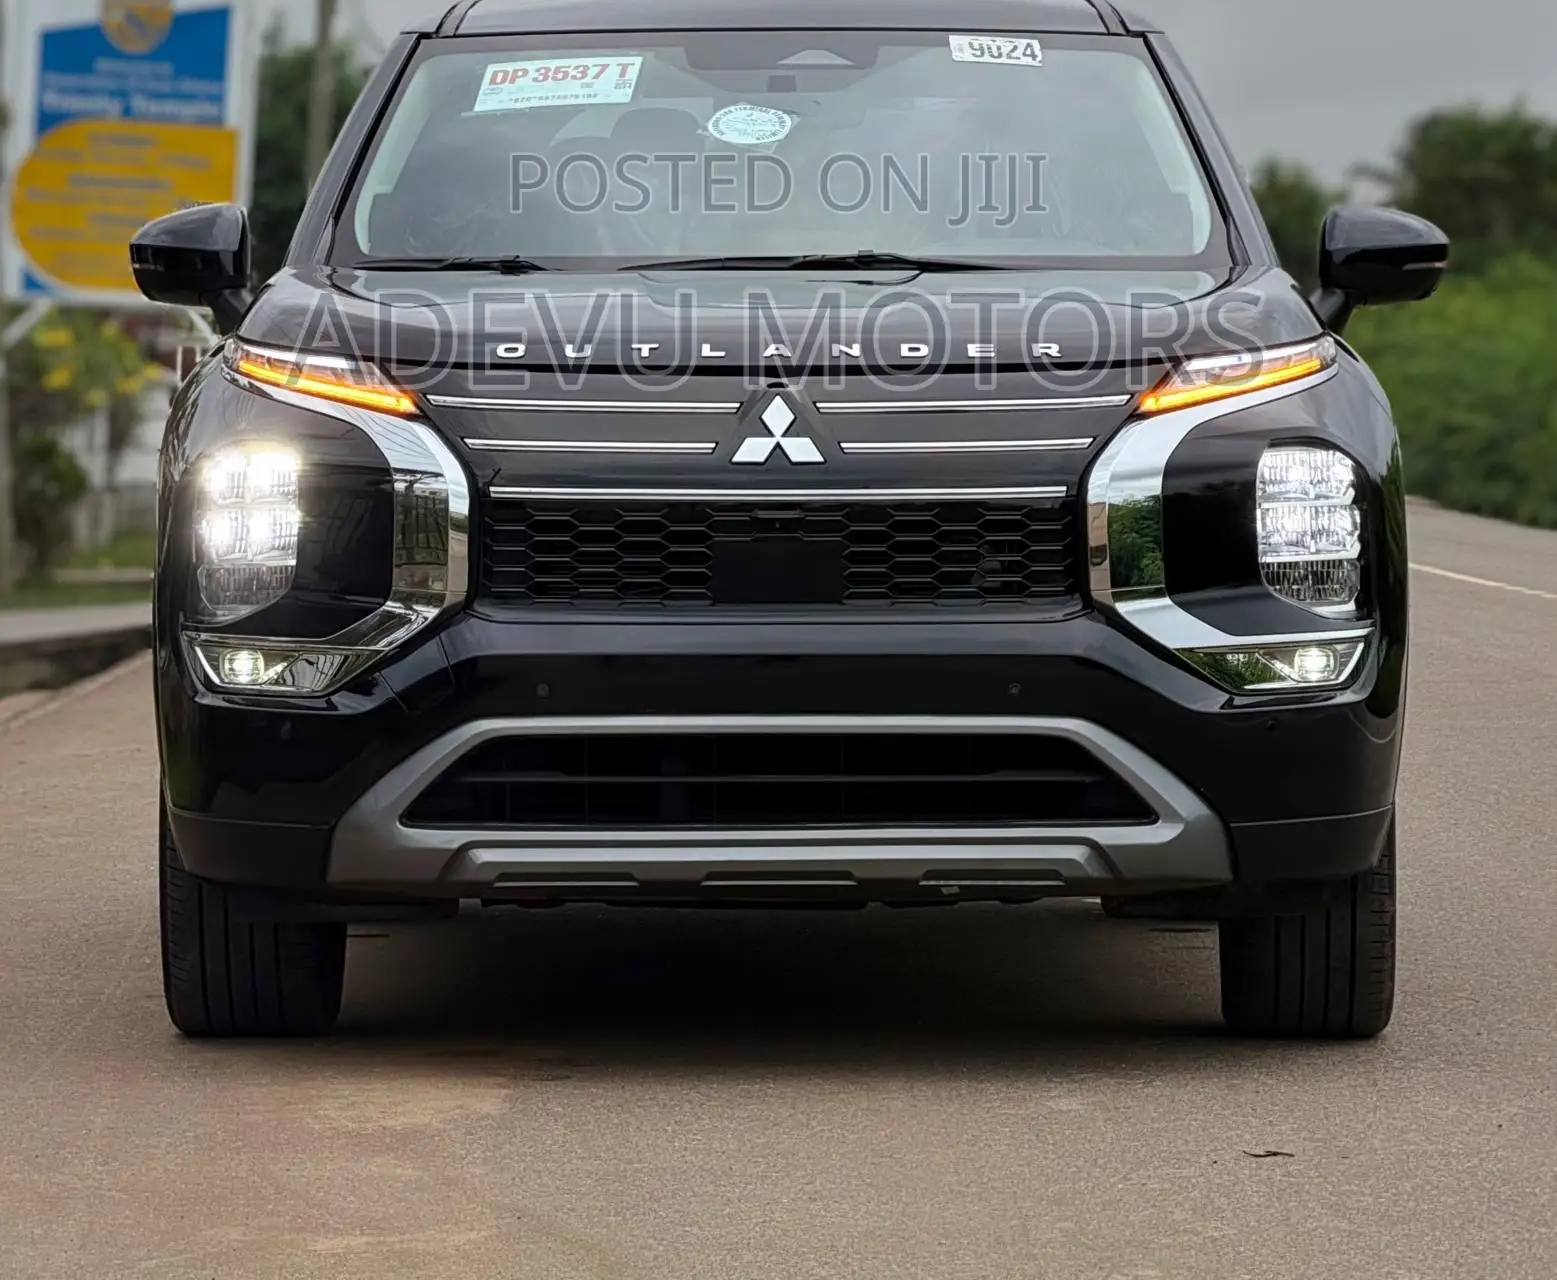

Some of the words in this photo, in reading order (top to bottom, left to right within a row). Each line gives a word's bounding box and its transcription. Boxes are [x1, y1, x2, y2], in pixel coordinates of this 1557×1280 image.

[968, 38, 1039, 61] 9024
[488, 67, 530, 86] DP
[531, 63, 611, 83] 3537
[616, 62, 636, 79] T
[495, 342, 1063, 358] OUTLANDER
